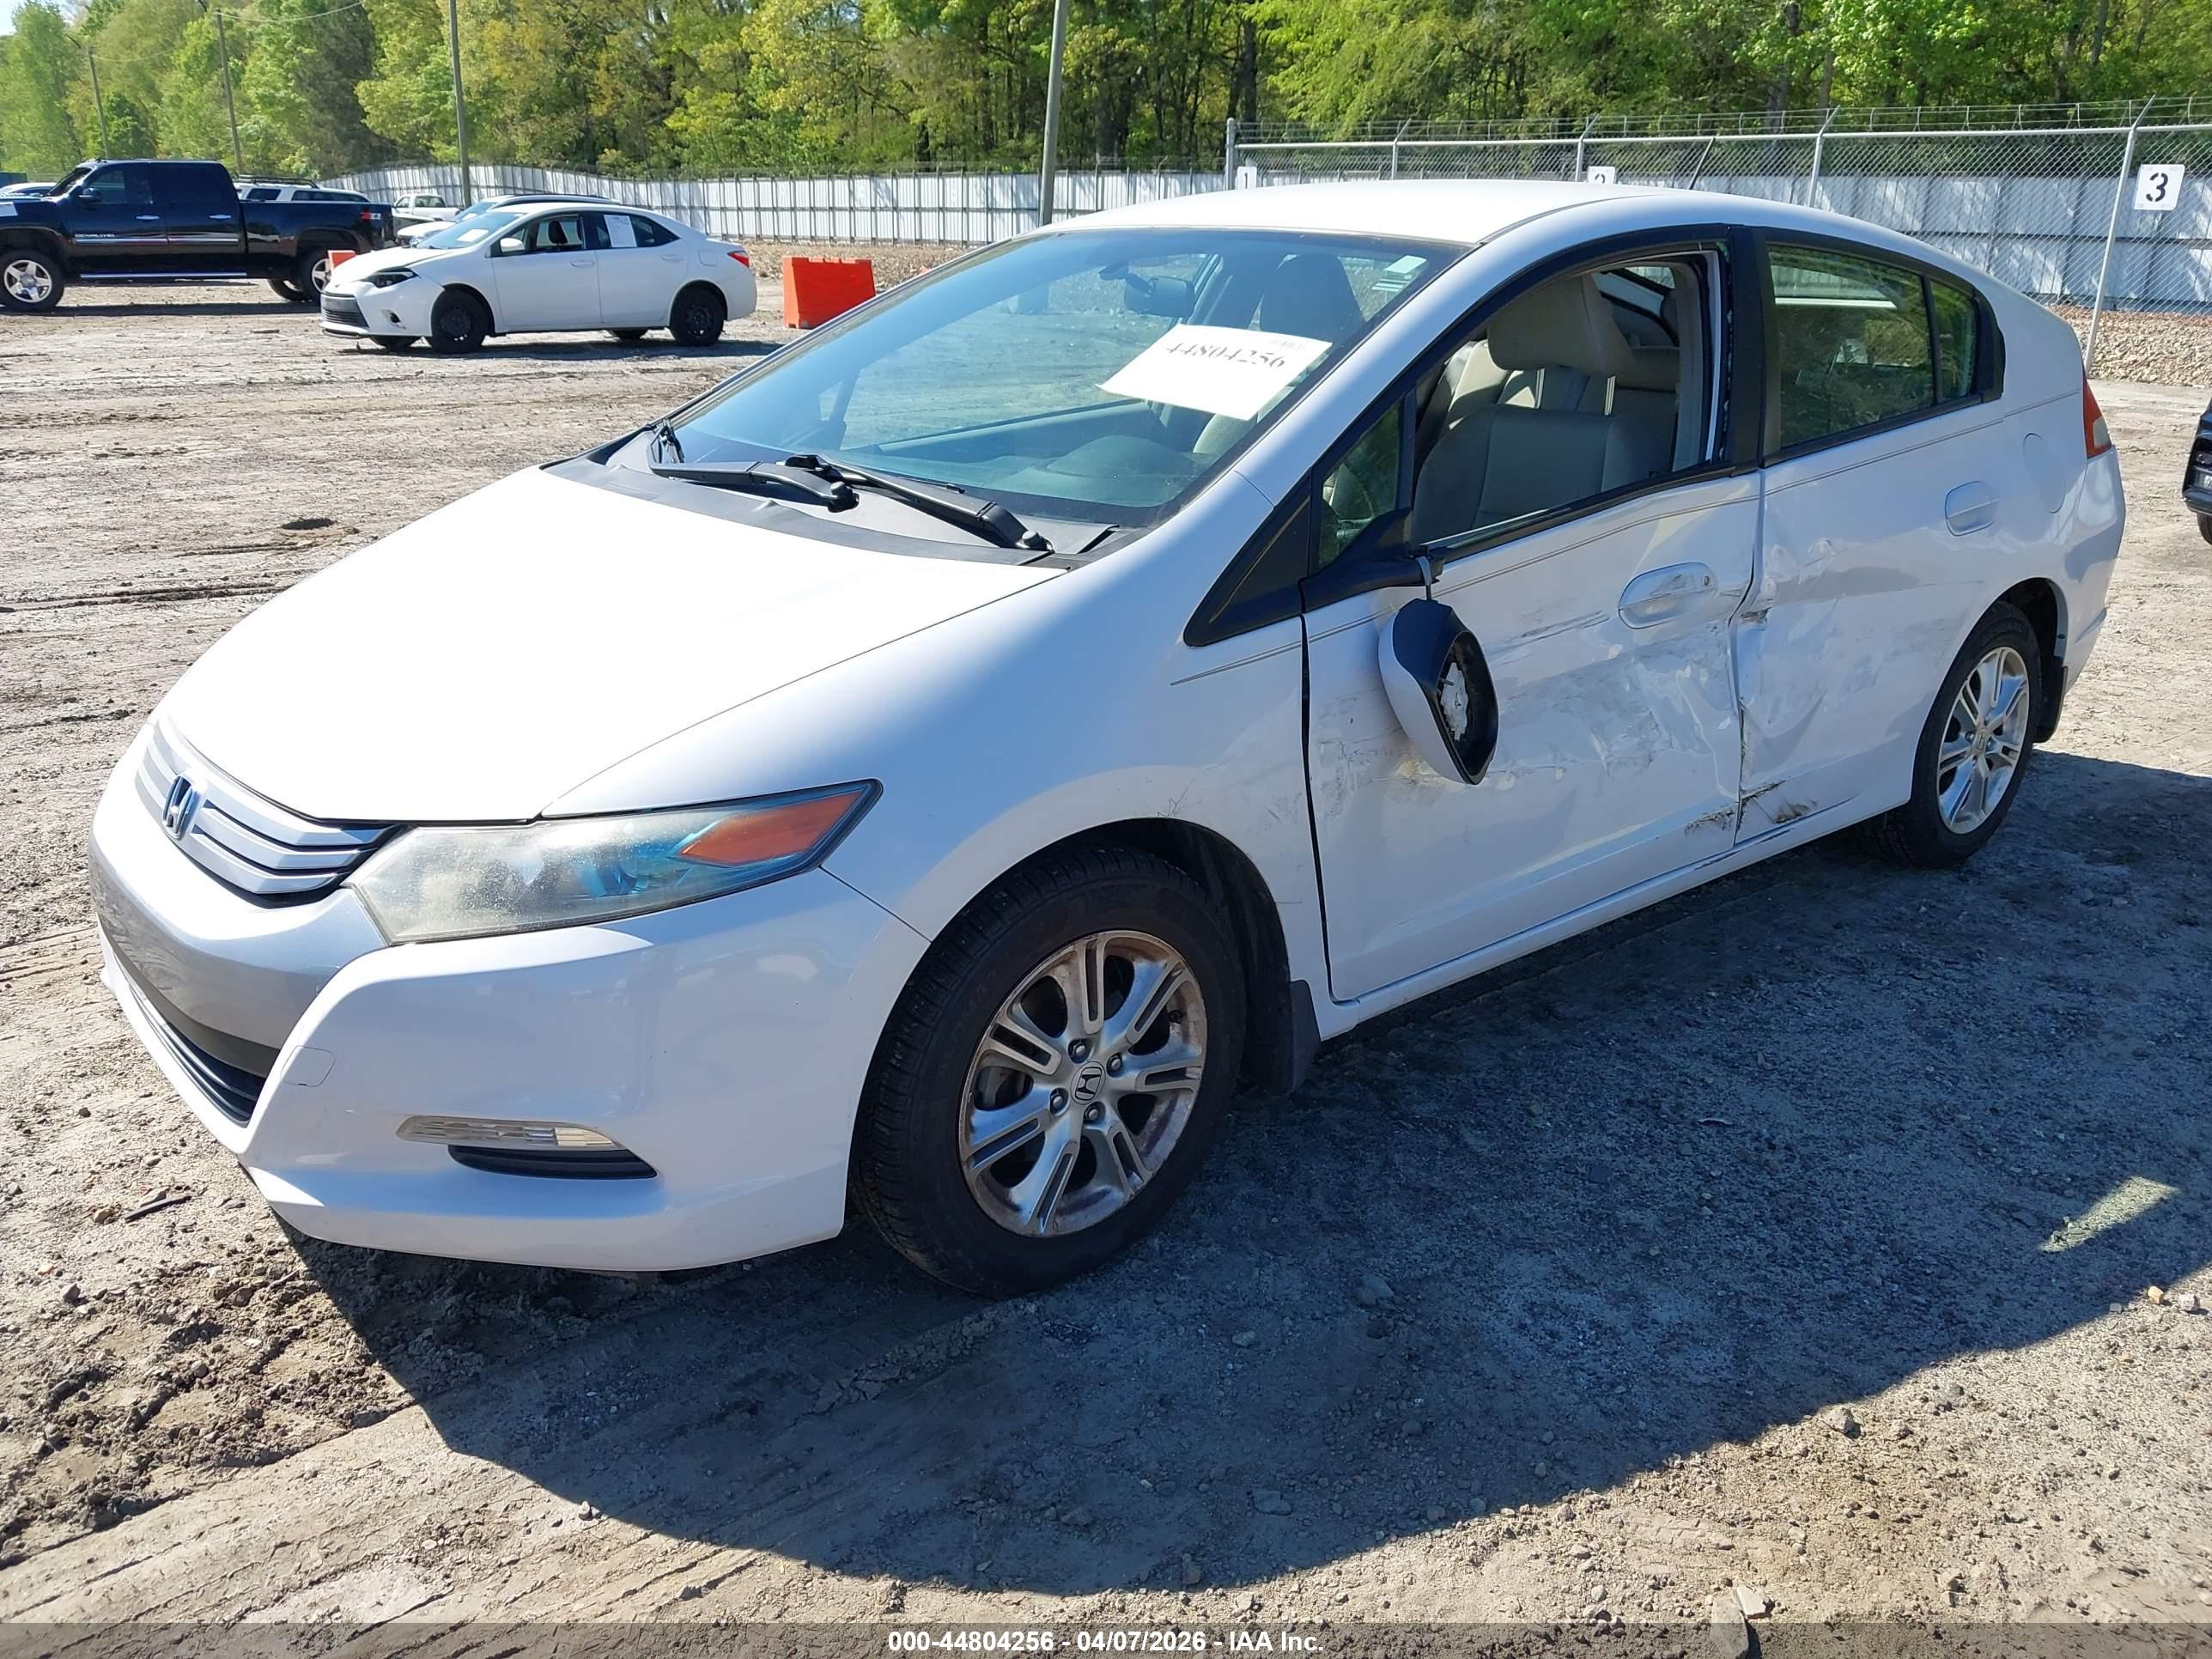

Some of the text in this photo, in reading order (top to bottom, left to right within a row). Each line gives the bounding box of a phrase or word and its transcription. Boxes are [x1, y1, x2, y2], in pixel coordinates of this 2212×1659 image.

[1244, 173, 1249, 190] 1
[2146, 173, 2169, 202] 3
[1165, 342, 1286, 368] 44804256
